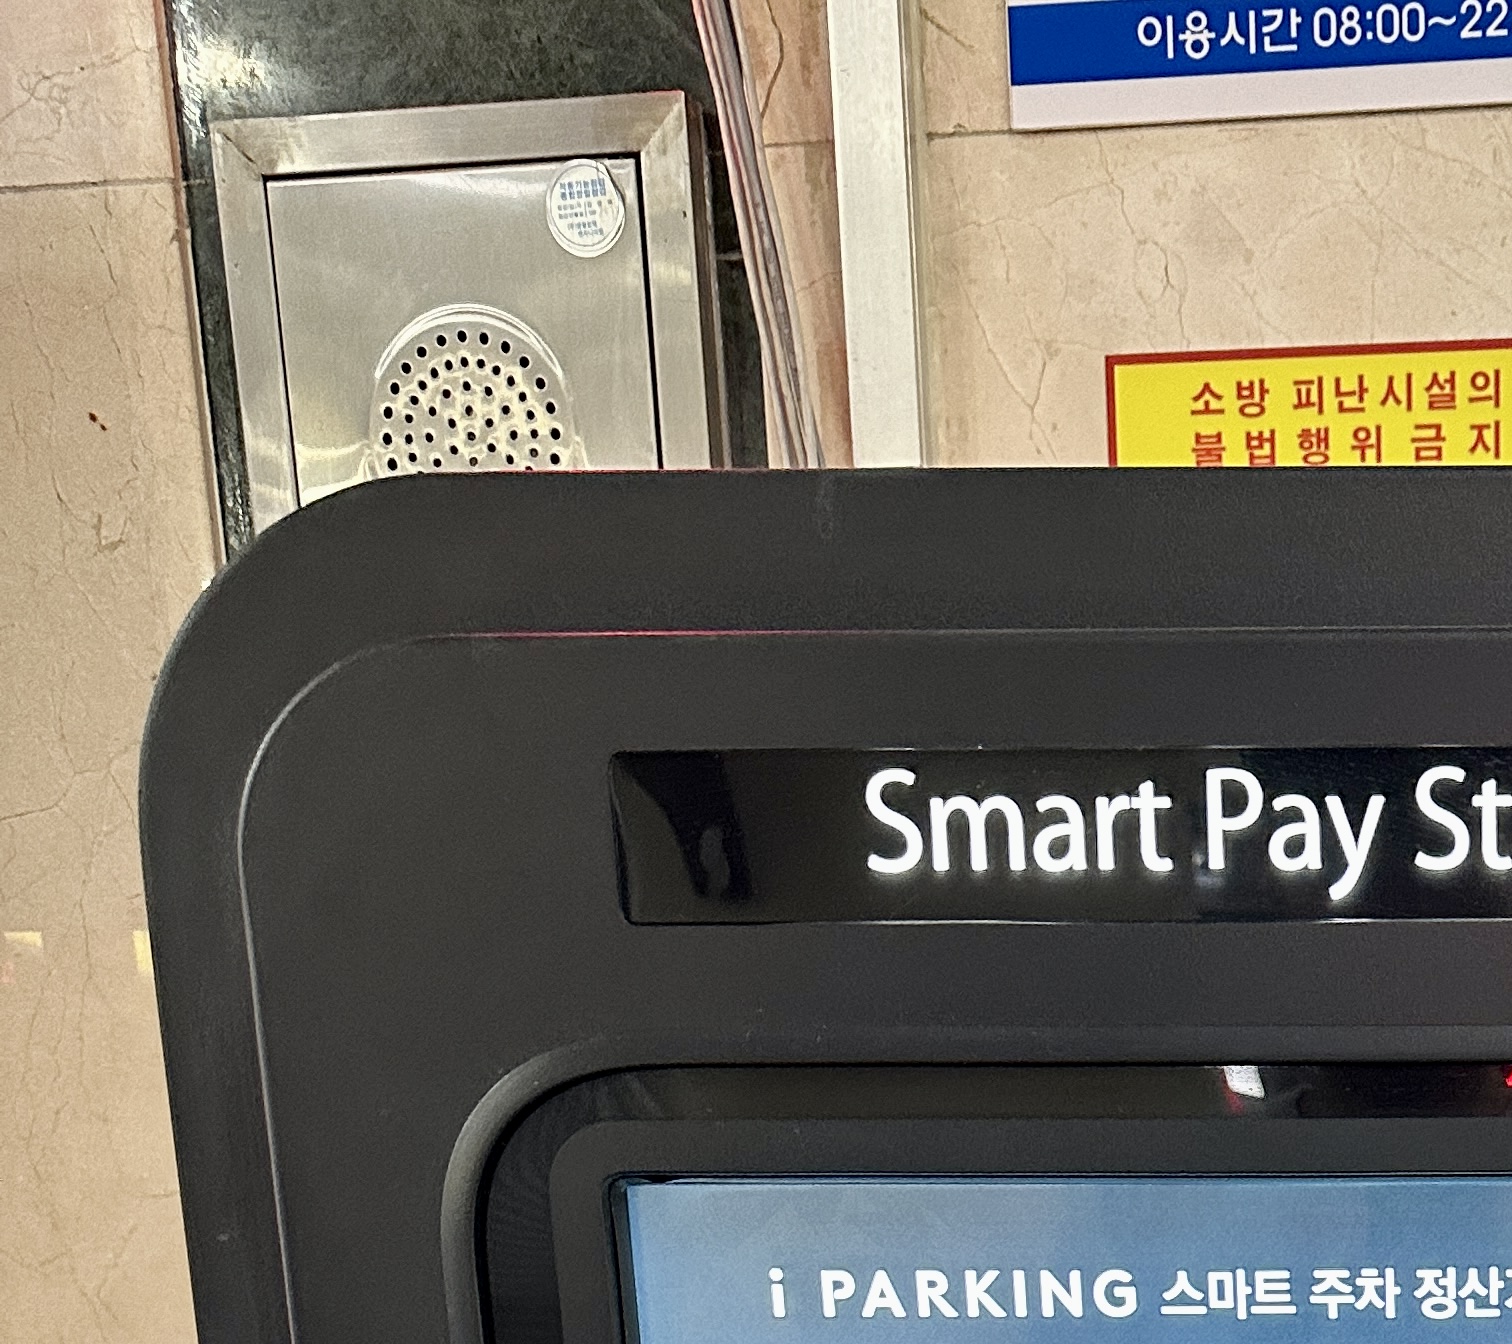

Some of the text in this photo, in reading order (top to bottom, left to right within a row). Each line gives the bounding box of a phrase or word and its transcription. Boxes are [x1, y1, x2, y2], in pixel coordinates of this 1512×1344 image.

[1137, 8, 1303, 60] 이용시간
[1190, 368, 1503, 418] 소방 피난시설의
[1410, 420, 1503, 463] 금지
[866, 767, 1174, 876] Smart
[1203, 769, 1385, 901] Pay
[768, 1266, 787, 1320] i
[819, 1267, 1139, 1320] PARKING
[1159, 1266, 1298, 1321] 스마트
[1309, 1267, 1402, 1321] 주차
